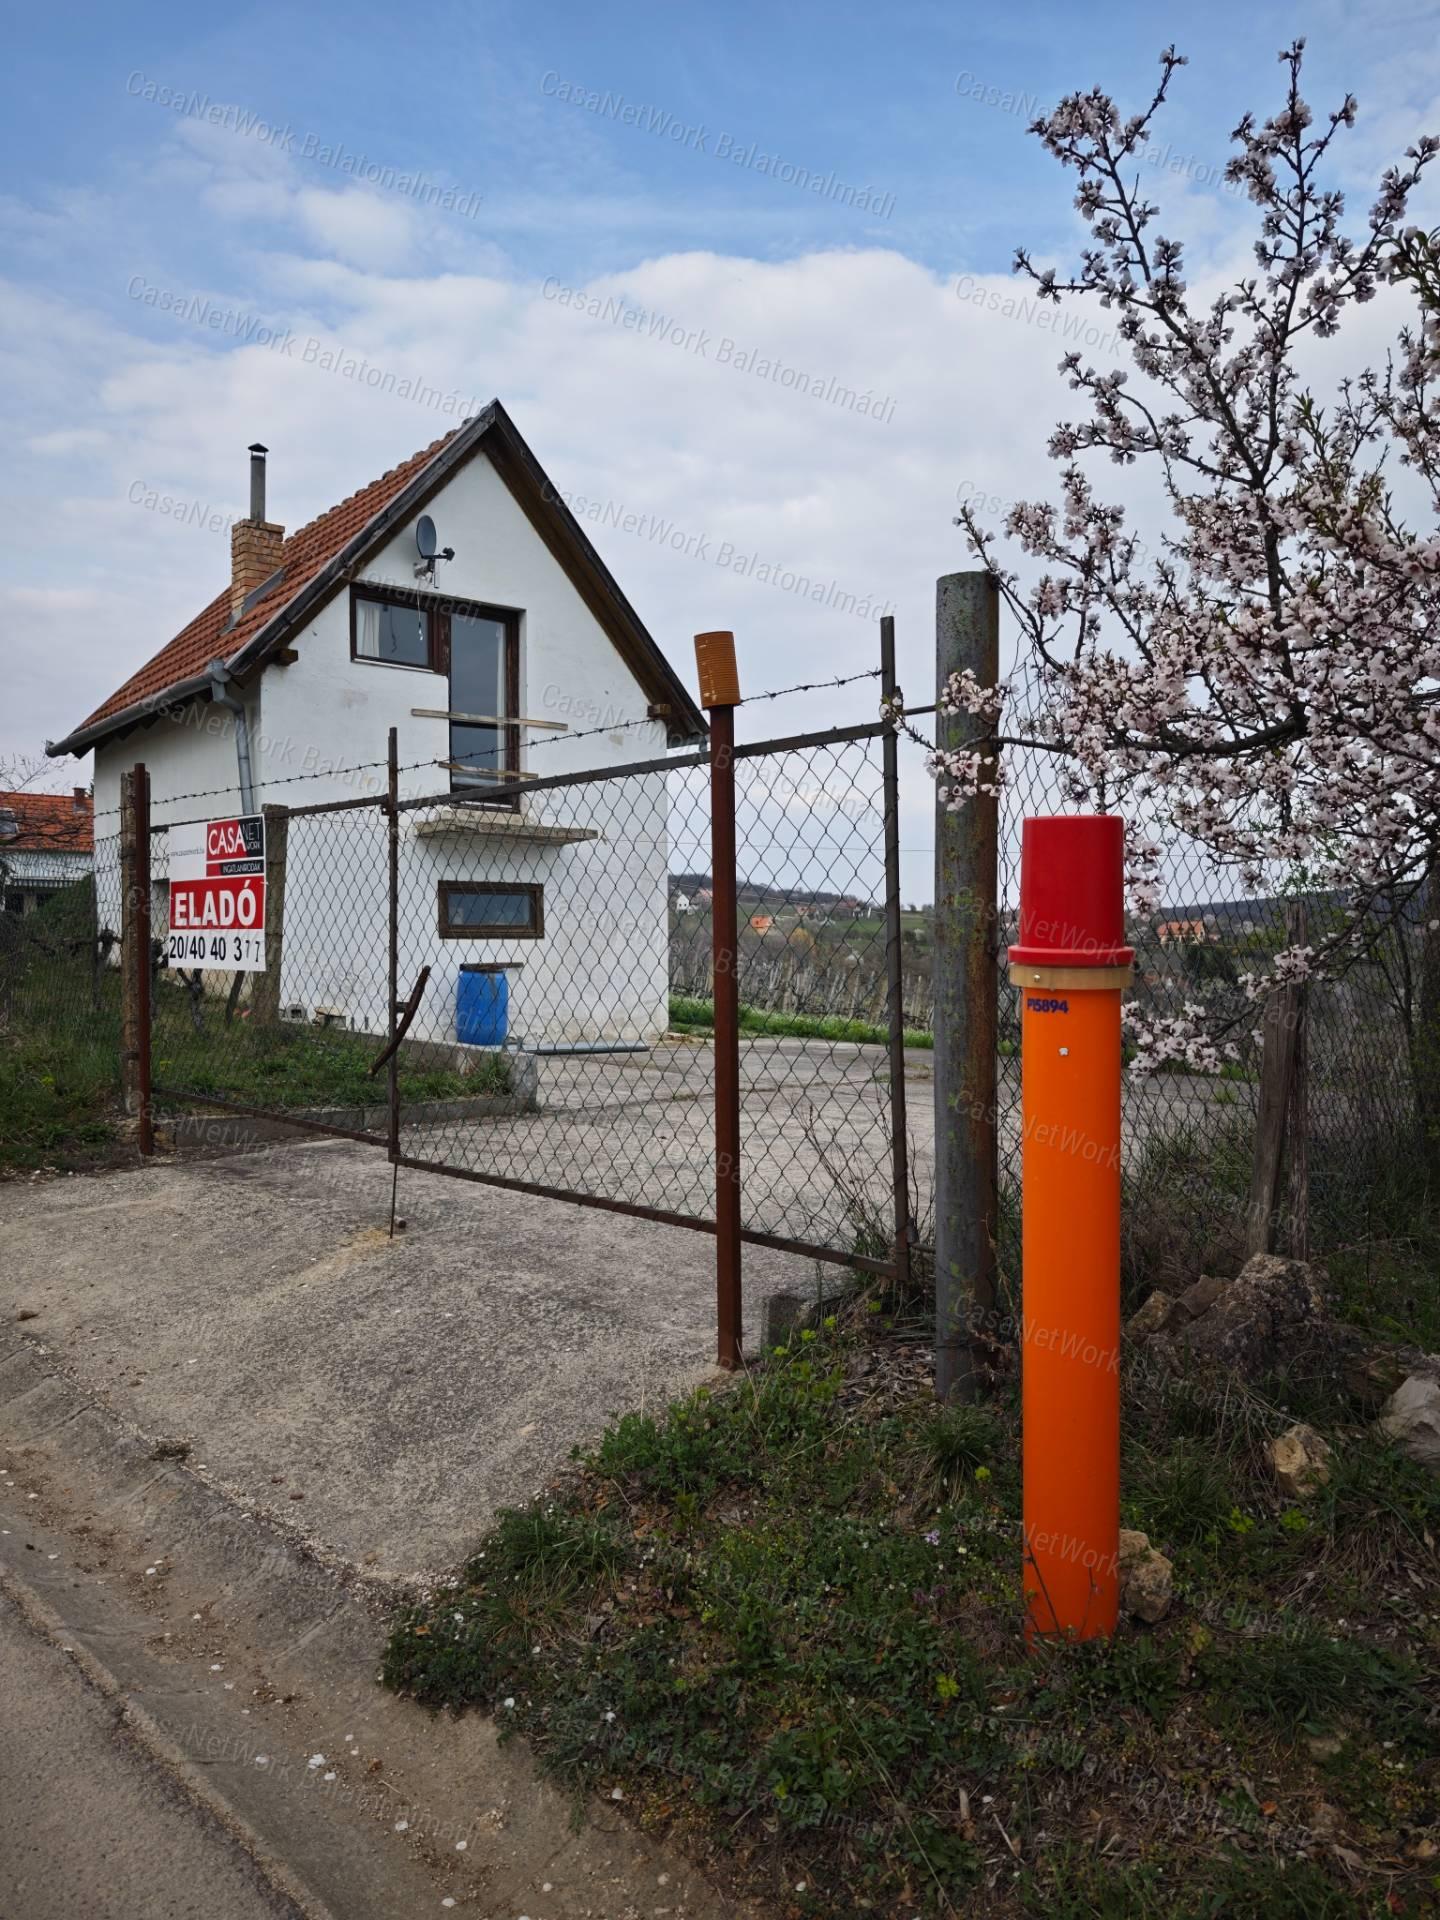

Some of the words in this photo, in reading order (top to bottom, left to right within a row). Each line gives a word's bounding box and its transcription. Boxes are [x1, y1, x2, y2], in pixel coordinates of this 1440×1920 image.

[208, 824, 247, 856] CASA
[174, 880, 257, 927] ELADÓ
[169, 935, 206, 960] 20/40
[210, 936, 227, 961] 40
